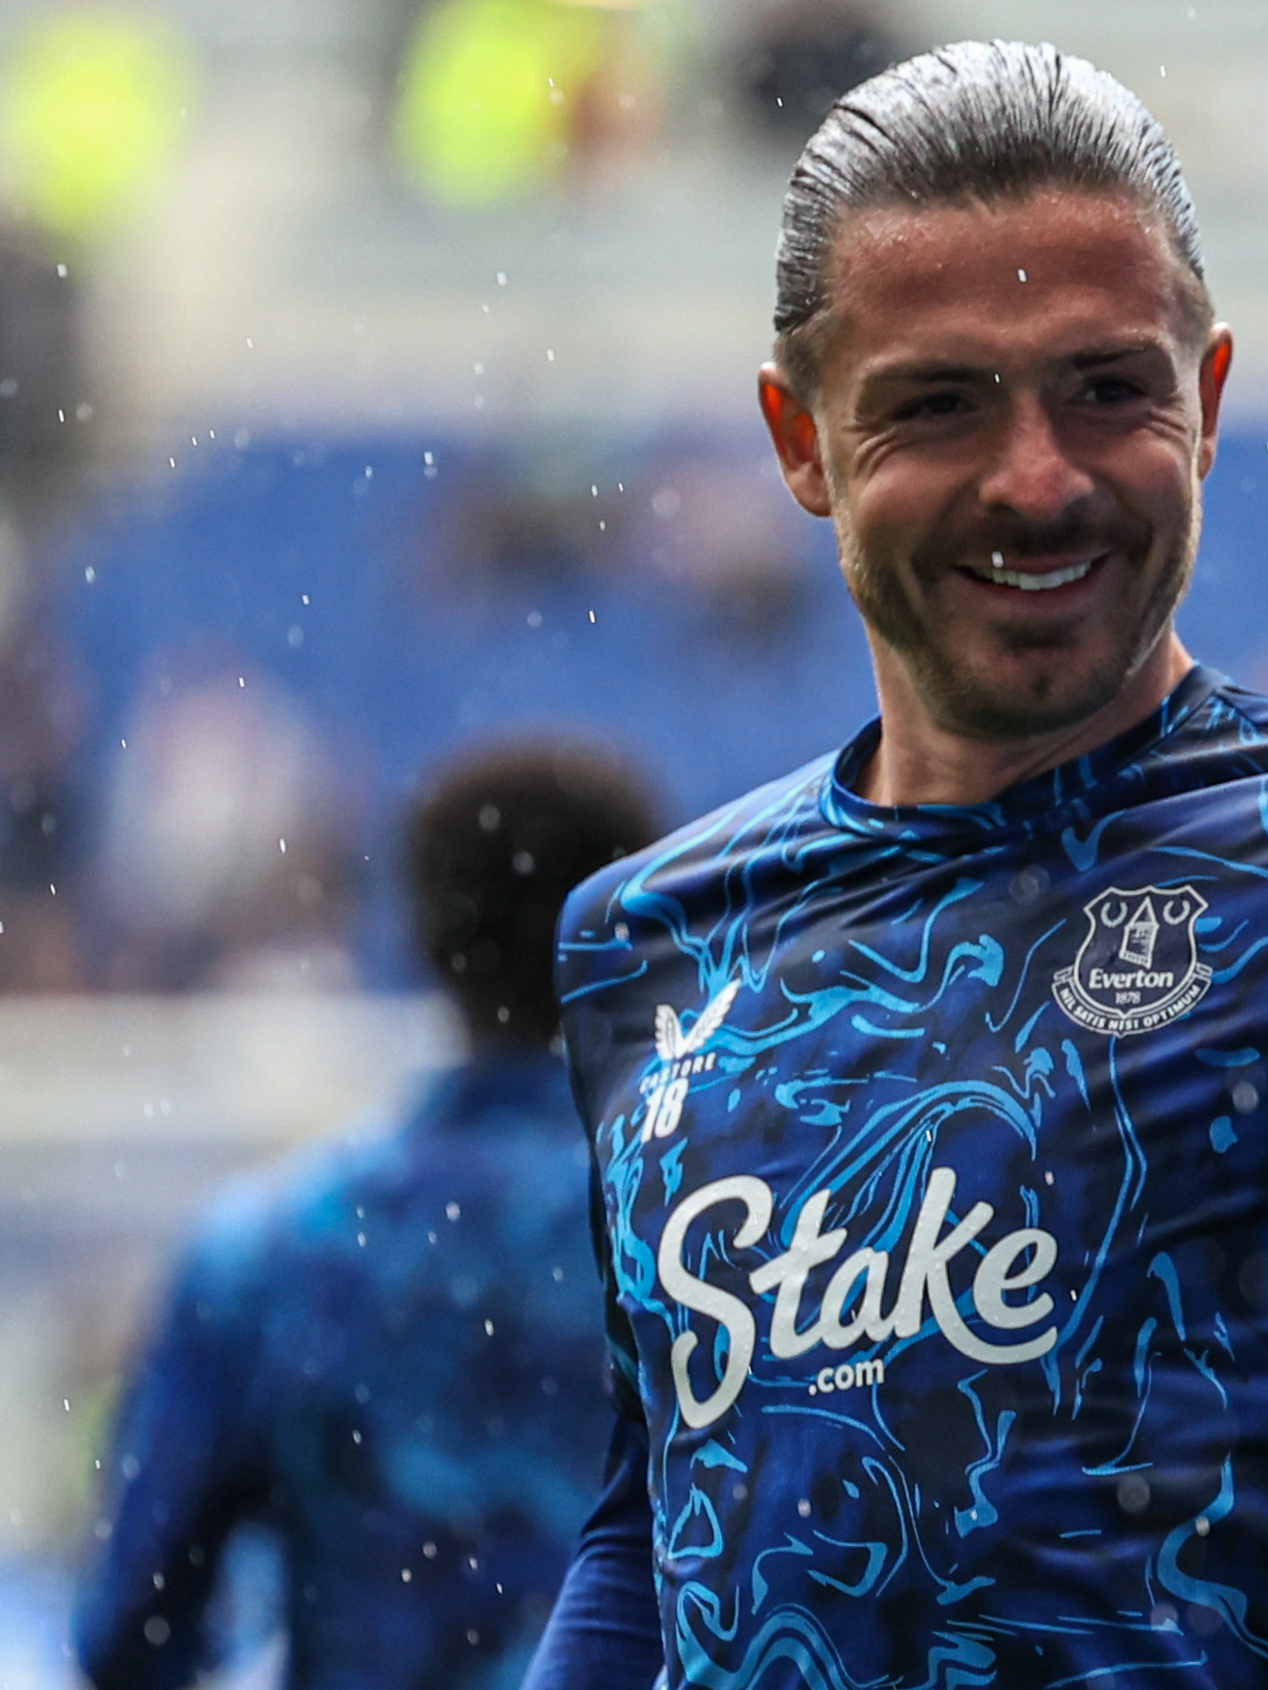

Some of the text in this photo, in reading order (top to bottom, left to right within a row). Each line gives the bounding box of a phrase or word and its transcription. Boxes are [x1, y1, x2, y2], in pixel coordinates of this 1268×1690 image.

[1089, 968, 1174, 989] Everton
[1115, 991, 1141, 1005] 1878
[1059, 985, 1200, 1031] NIL SATIS NISI OPTIMUM
[641, 1077, 689, 1143] 18
[658, 1167, 1058, 1429] Stake
[808, 1358, 885, 1396] .com
